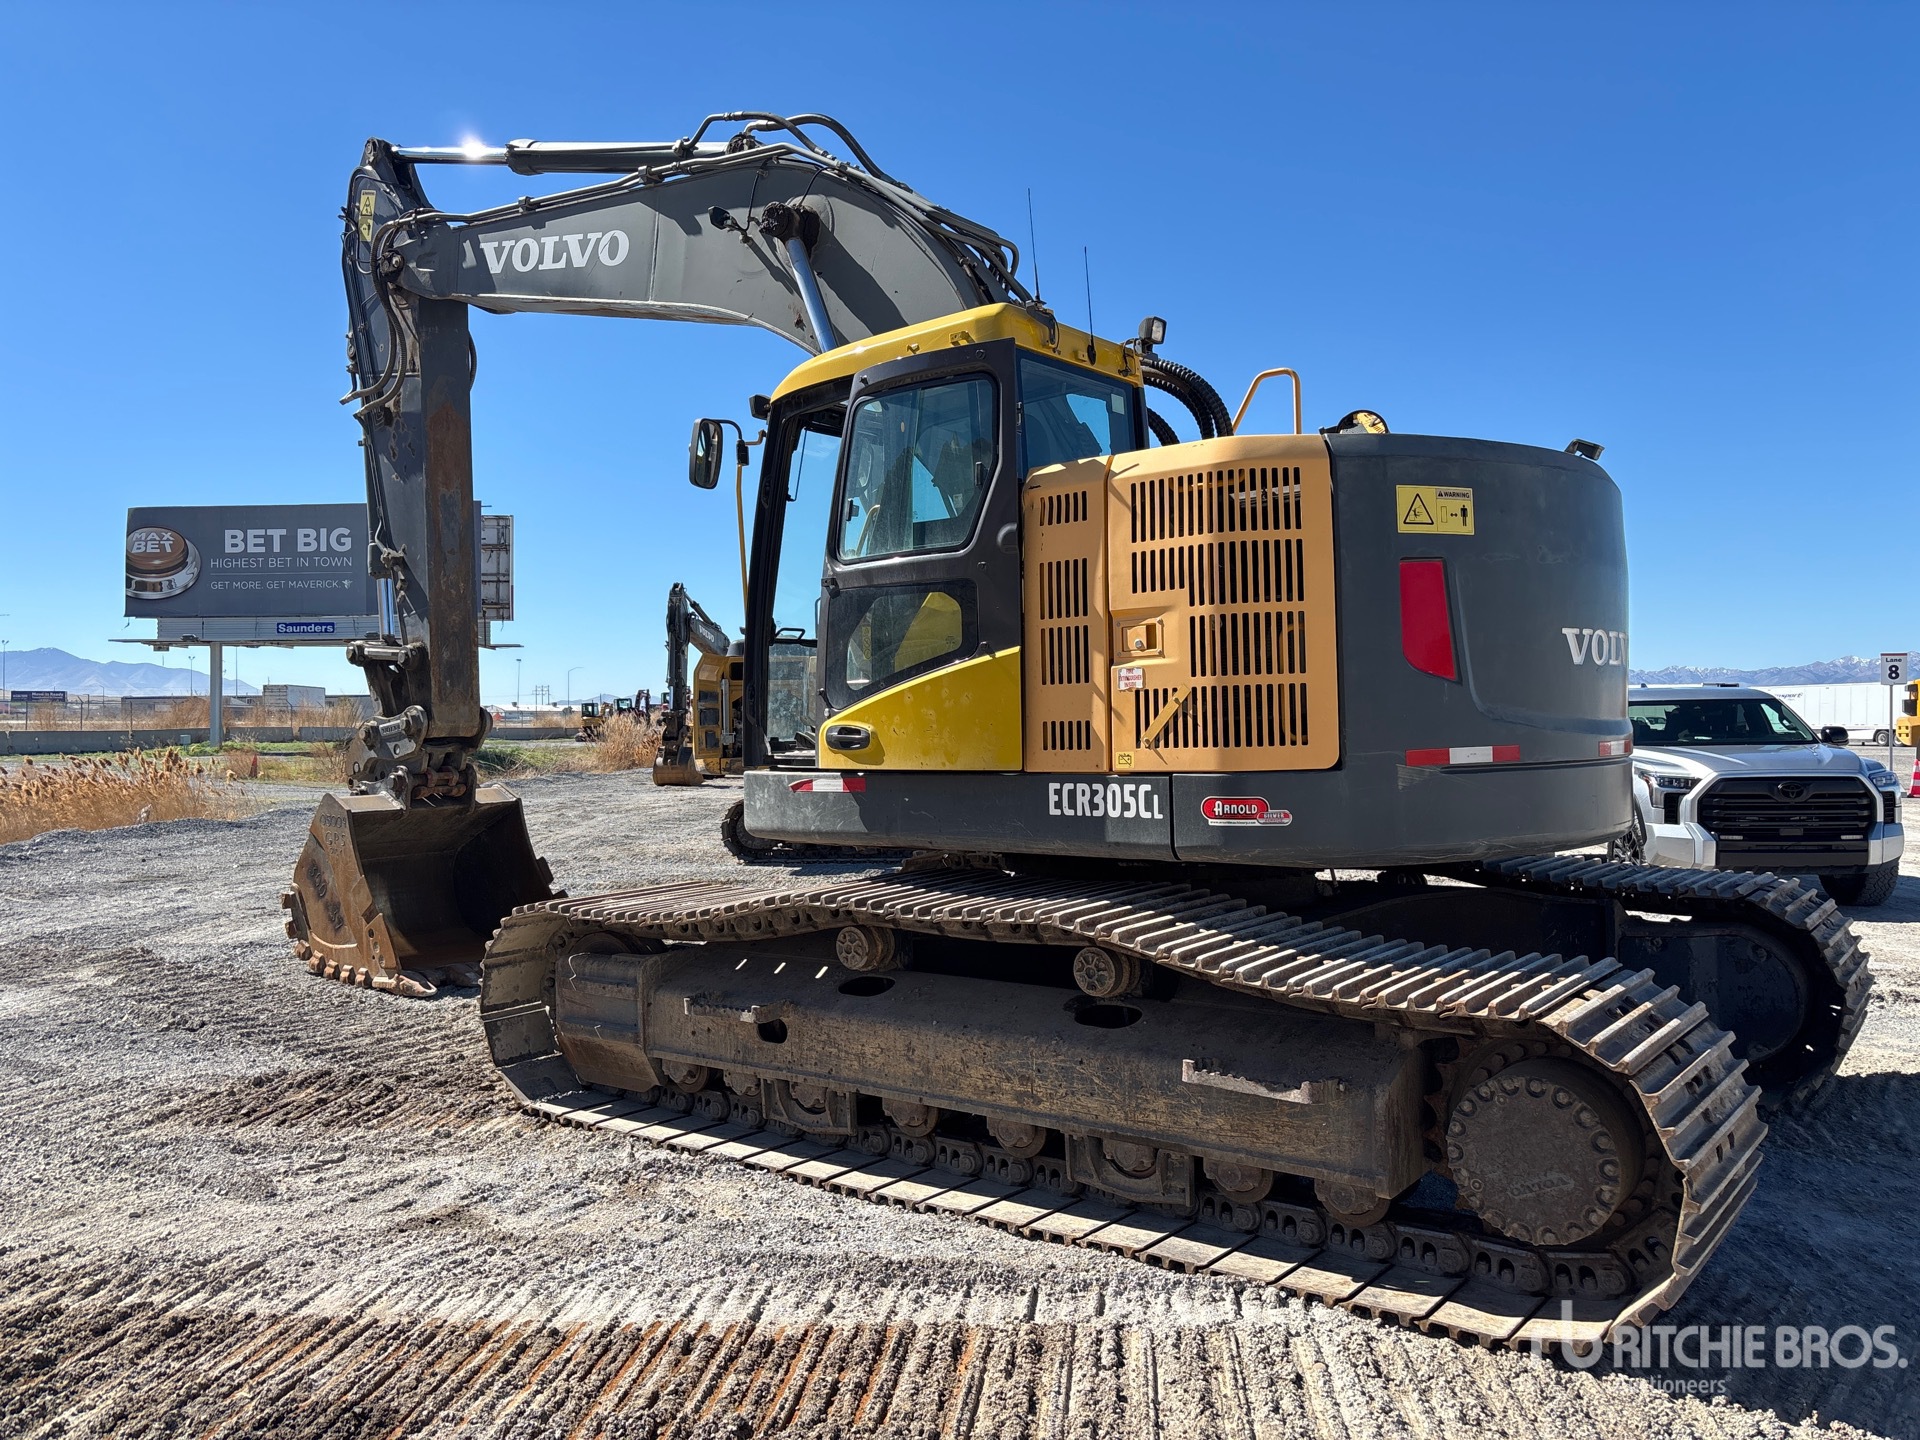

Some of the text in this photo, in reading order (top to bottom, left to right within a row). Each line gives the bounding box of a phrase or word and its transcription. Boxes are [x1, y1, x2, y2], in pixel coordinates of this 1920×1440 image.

[480, 230, 630, 274] VOLVO
[1444, 491, 1470, 499] WARNING
[132, 532, 175, 541] MAX
[224, 527, 352, 553] BET BIG
[131, 540, 174, 553] BET
[210, 556, 352, 568] HIGHEST BET IN TOWN
[210, 580, 341, 590] GET MORE. GET MAVERICK.
[278, 624, 334, 633] Saunders
[1888, 664, 1900, 680] 8
[1213, 800, 1258, 816] ARNOLD
[325, 831, 346, 847] GPS
